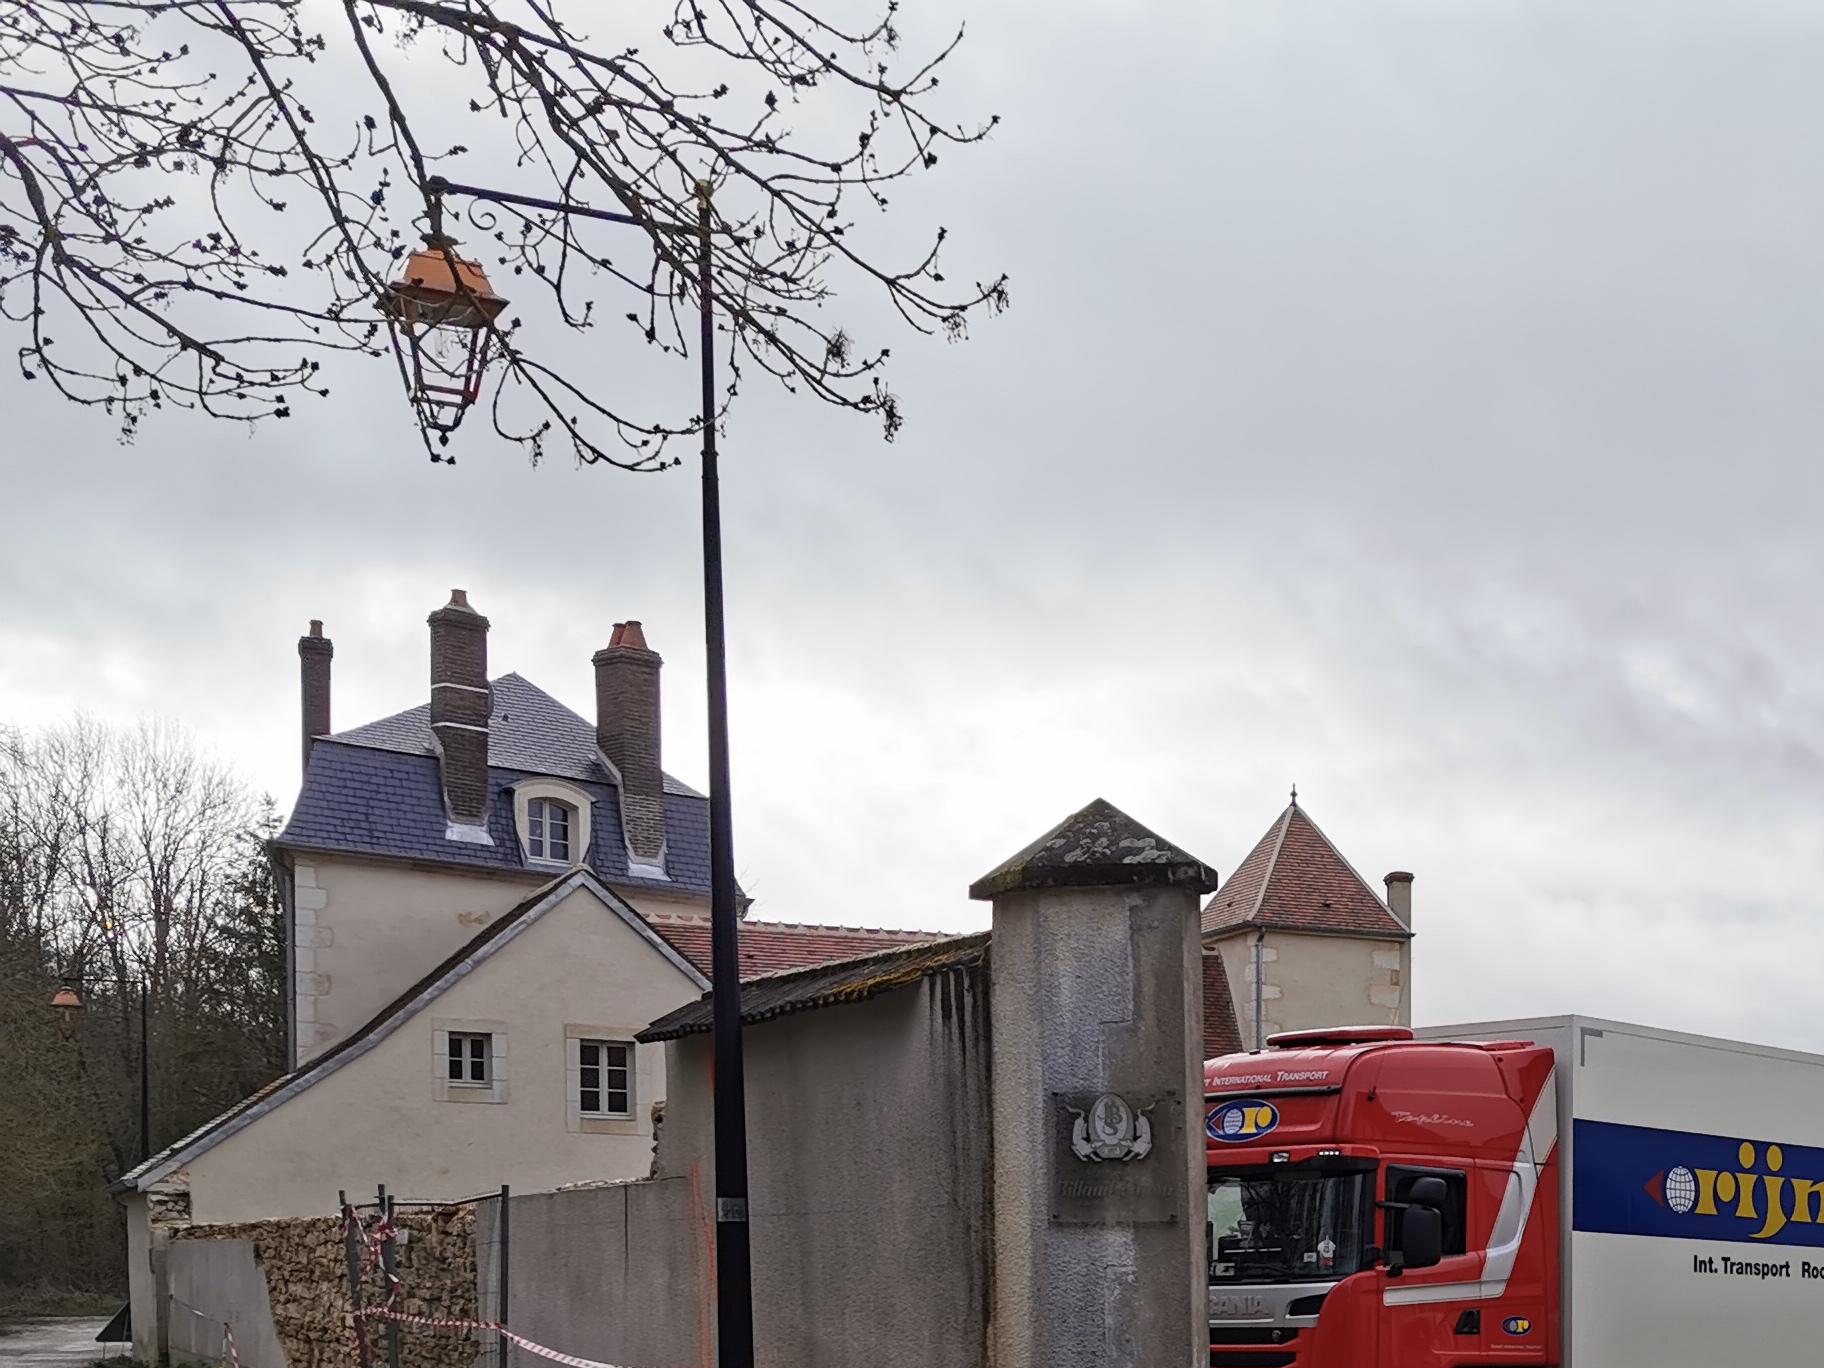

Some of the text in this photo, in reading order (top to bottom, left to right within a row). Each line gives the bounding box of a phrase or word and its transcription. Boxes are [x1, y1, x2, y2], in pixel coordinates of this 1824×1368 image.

[1277, 1071, 1329, 1081] TRANSPORT
[1694, 1255, 1718, 1274] Int.
[1721, 1257, 1790, 1280] Transport
